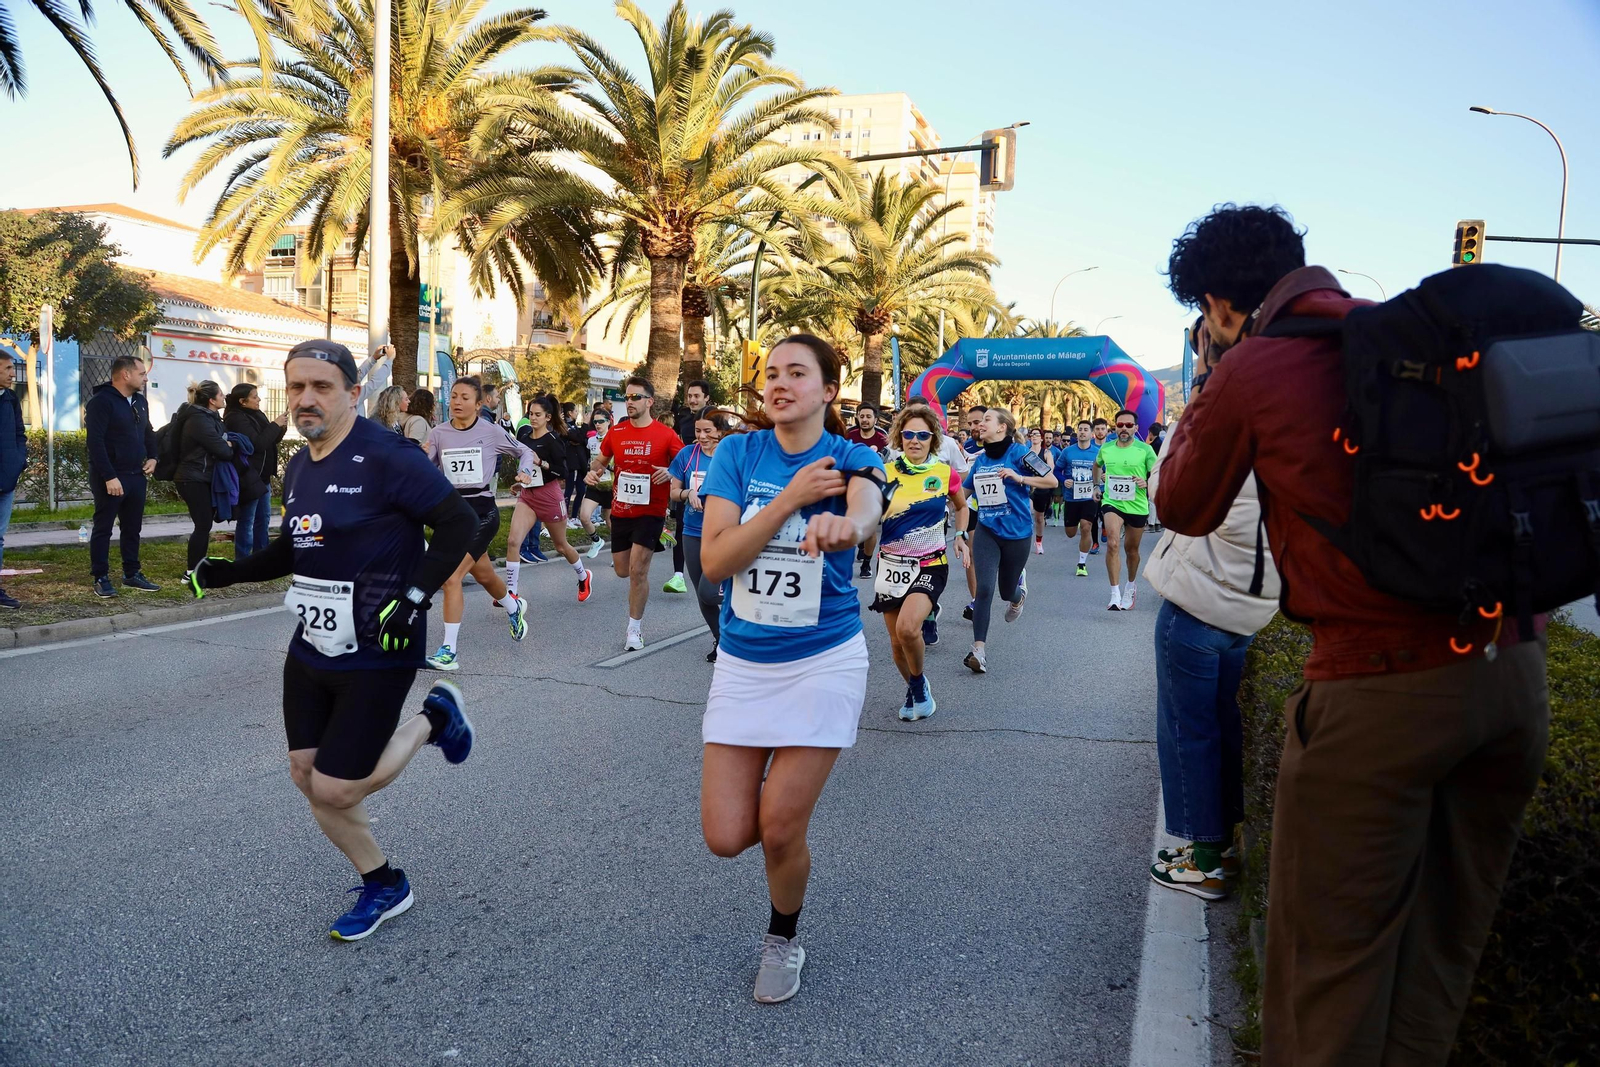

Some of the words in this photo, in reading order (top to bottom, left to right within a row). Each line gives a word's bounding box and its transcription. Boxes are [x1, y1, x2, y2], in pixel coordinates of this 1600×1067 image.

[992, 353, 1044, 361] Ayuntamiento
[1058, 351, 1086, 360] Málaga
[451, 460, 475, 473] 371
[339, 485, 363, 495] mupol
[623, 483, 643, 495] 191
[757, 481, 784, 491] CARRERA
[981, 483, 998, 495] 172
[1078, 486, 1092, 494] 516
[1112, 484, 1130, 493] 423
[289, 513, 323, 535] 200
[885, 568, 911, 584] 208
[748, 568, 802, 598] 173
[296, 603, 338, 632] 328
